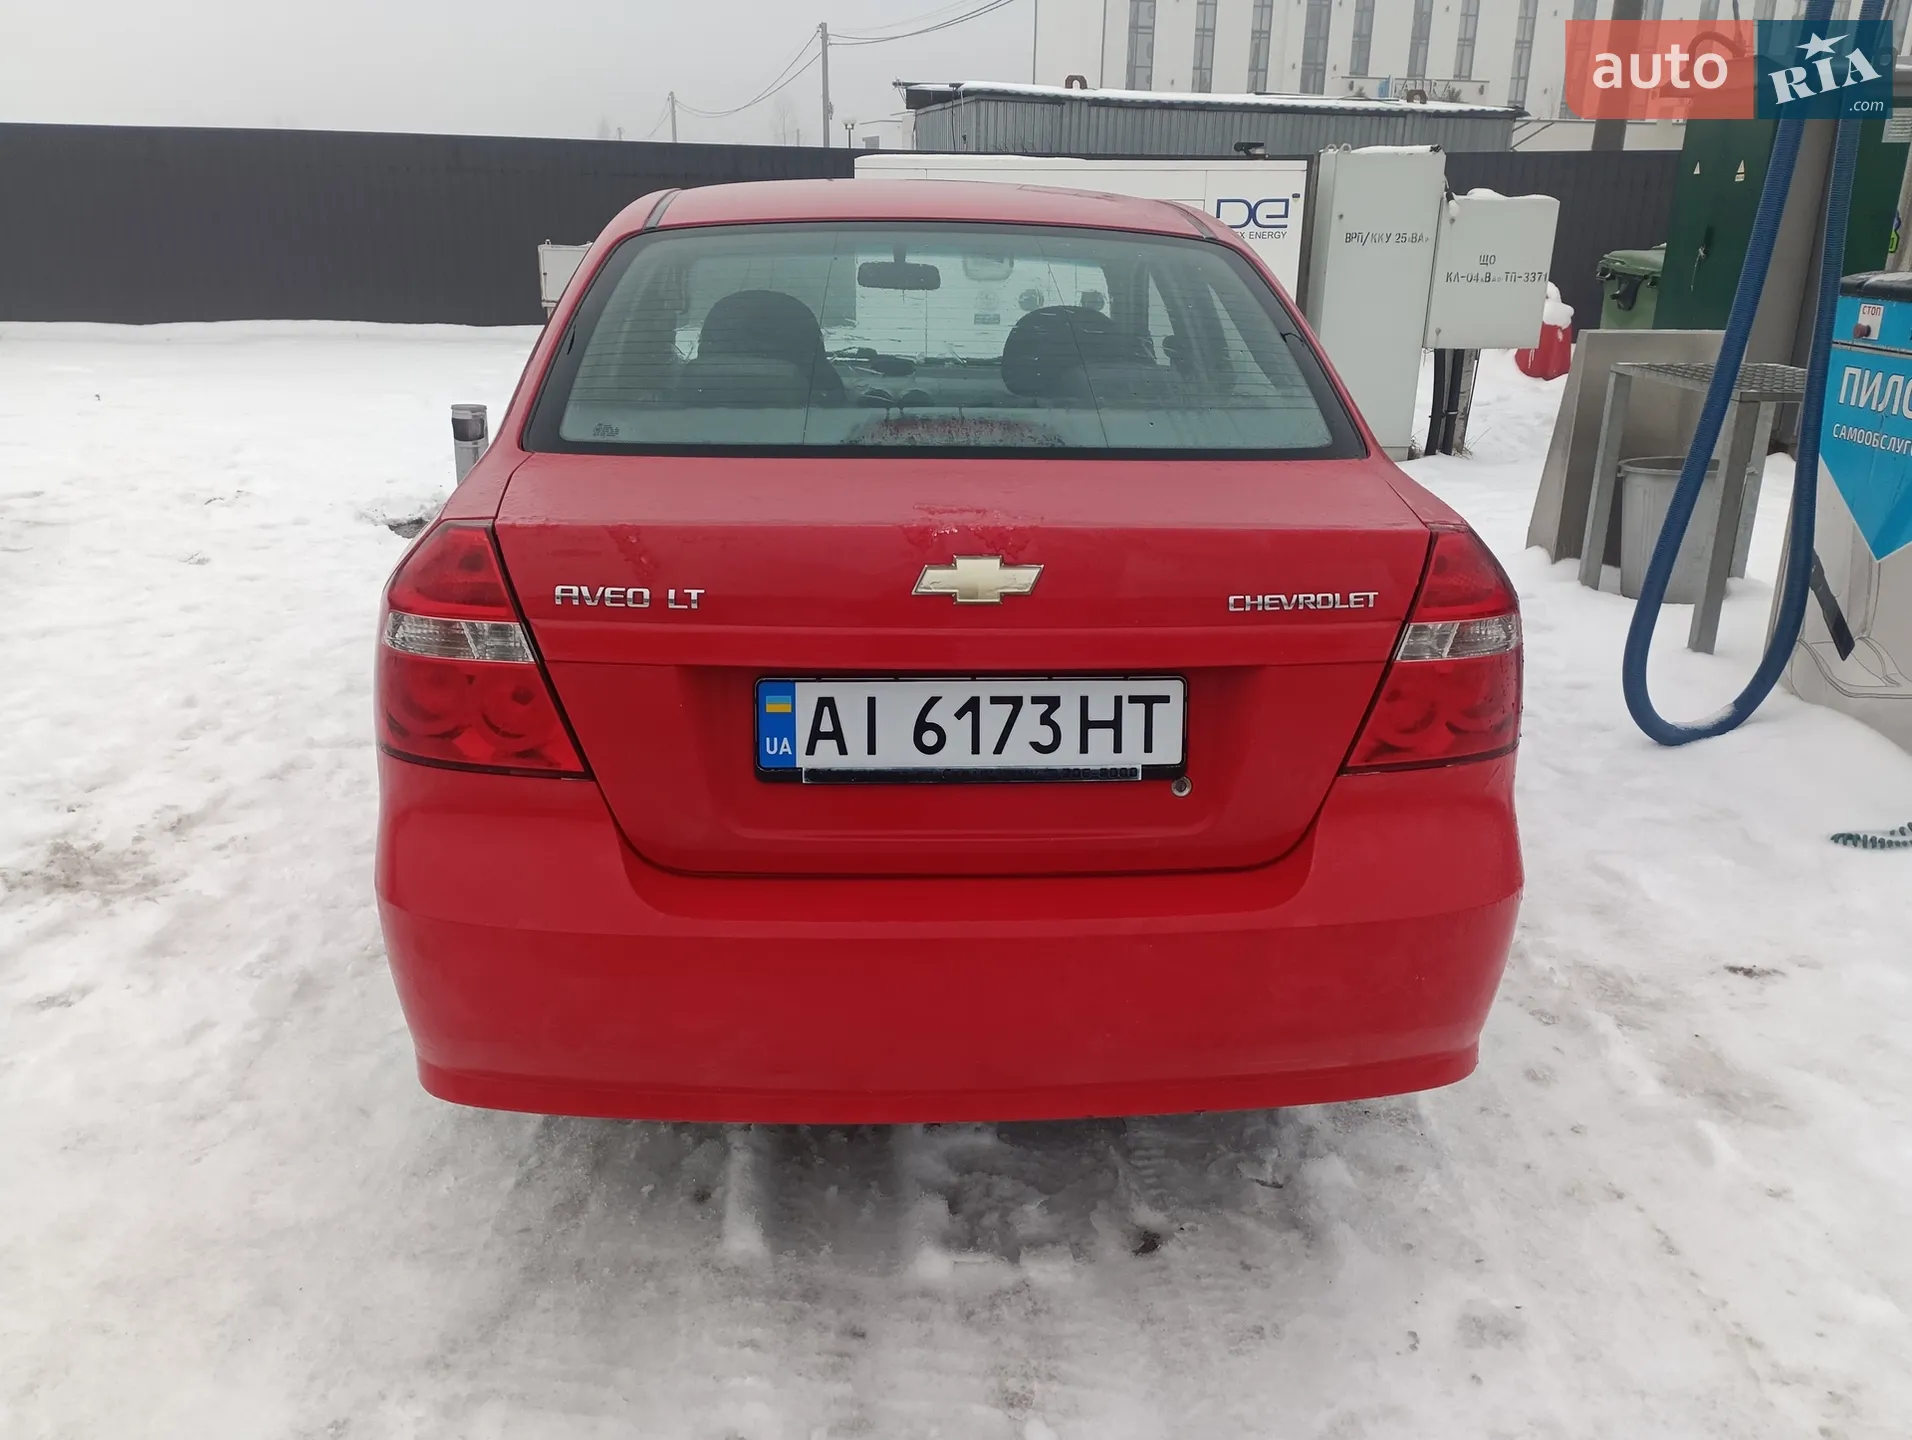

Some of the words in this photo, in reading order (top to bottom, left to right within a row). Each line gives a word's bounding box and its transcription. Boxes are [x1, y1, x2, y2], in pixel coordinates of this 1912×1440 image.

[1249, 231, 1288, 240] ENERGY
[1479, 254, 1496, 266] ЩО
[1504, 271, 1548, 283] ТП-3371
[1862, 305, 1882, 317] СТОП
[554, 584, 651, 608] AVEO
[667, 588, 706, 609] LT
[1227, 591, 1379, 612] CHEVROLET
[805, 695, 876, 756] AI
[765, 737, 793, 756] UA
